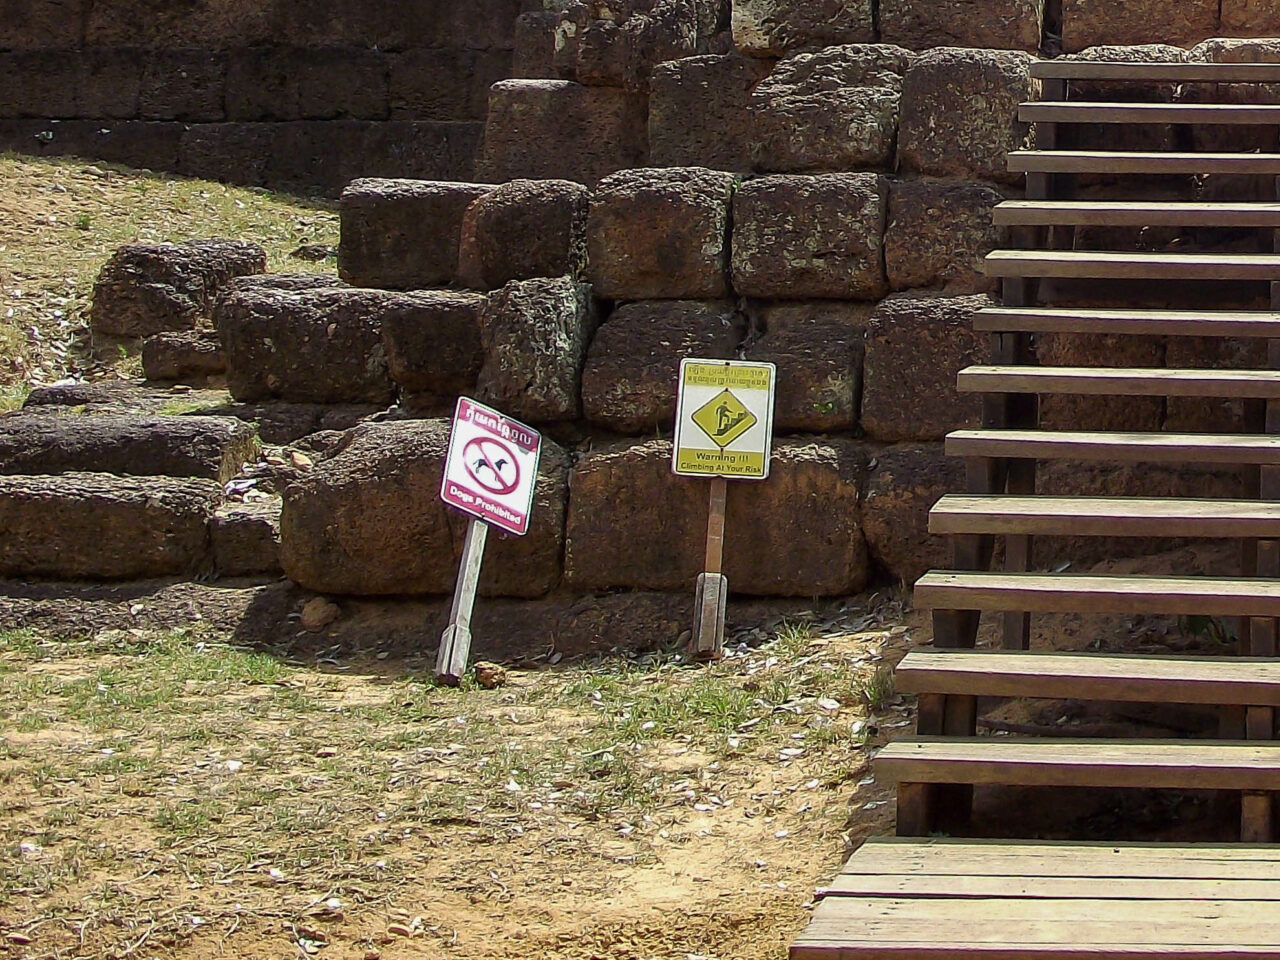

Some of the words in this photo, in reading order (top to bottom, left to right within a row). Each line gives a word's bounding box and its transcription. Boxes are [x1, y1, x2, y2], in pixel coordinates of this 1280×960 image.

[696, 452, 736, 463] Warning
[680, 462, 714, 472] Climbing
[449, 485, 474, 503] Dogs
[474, 497, 521, 525] Prohibited
